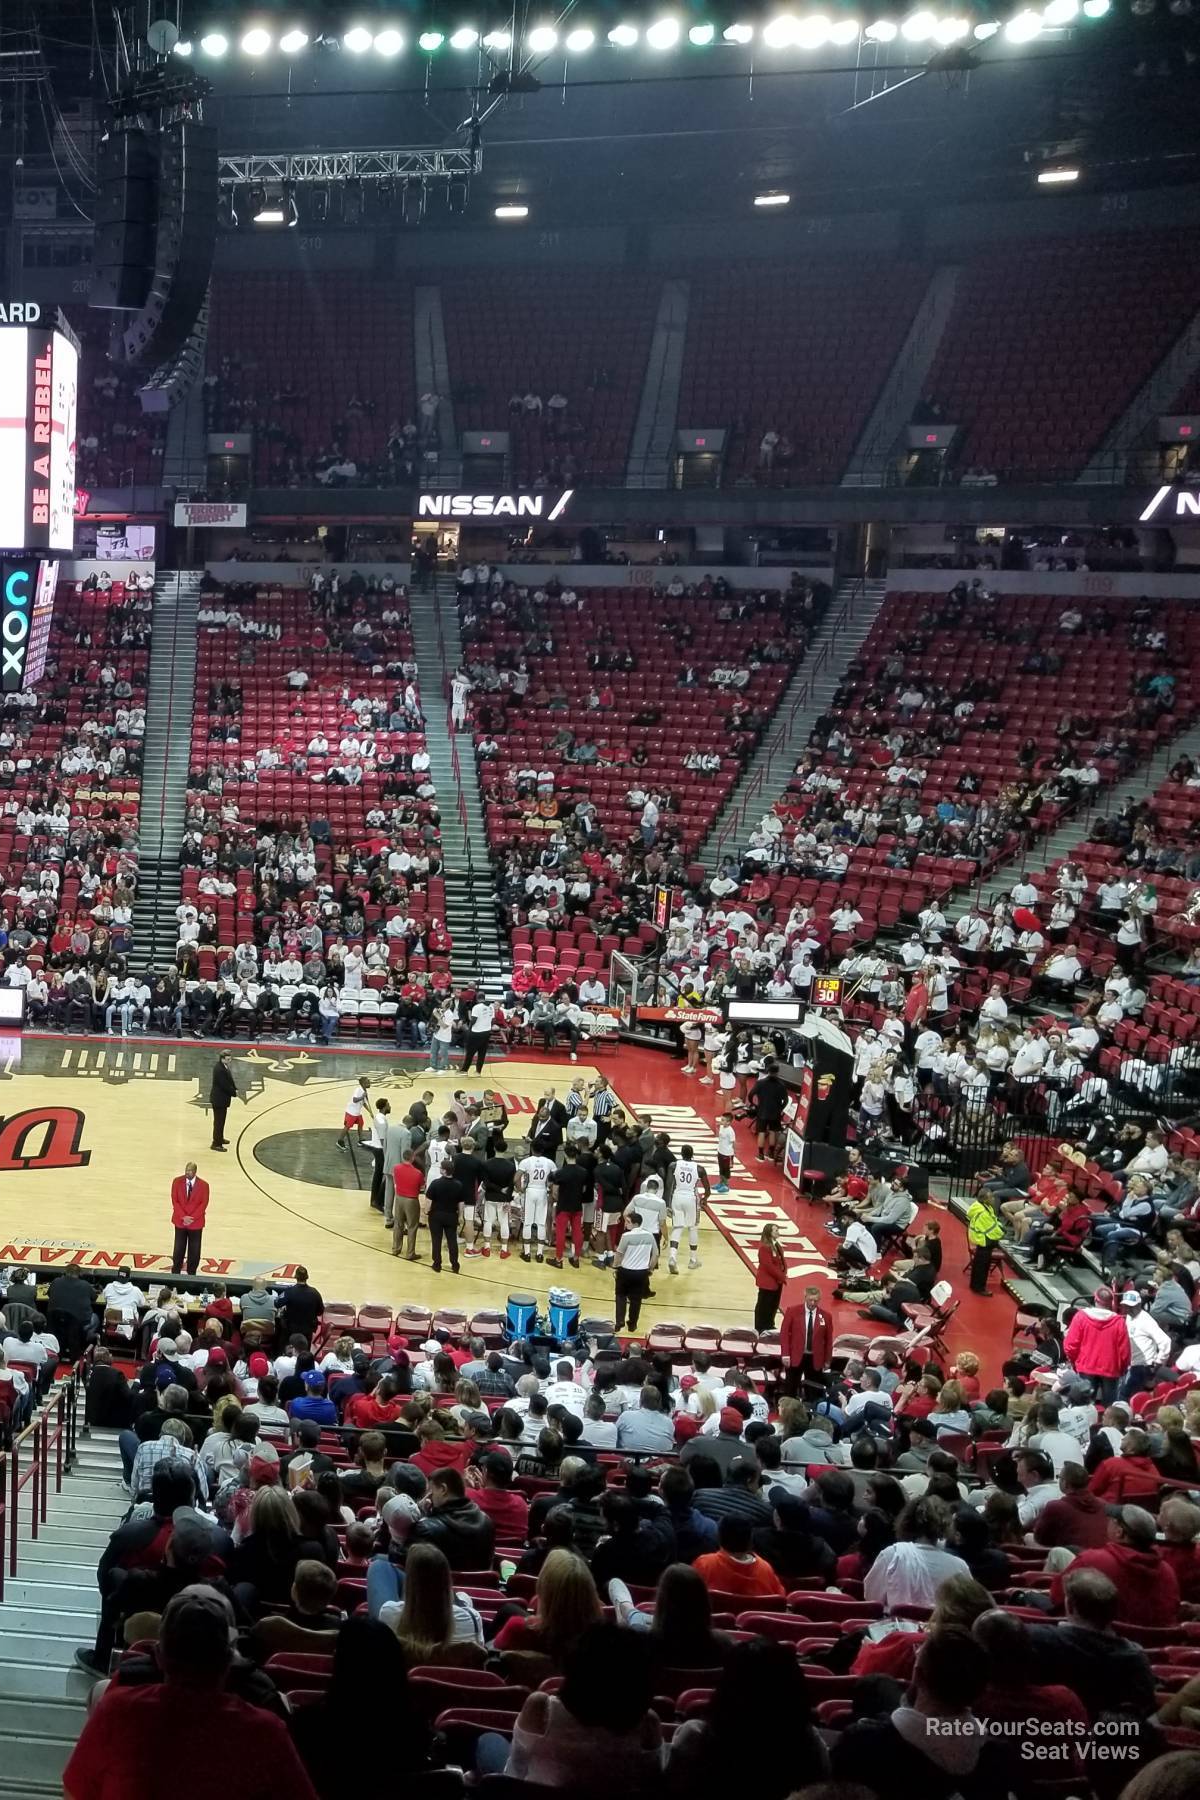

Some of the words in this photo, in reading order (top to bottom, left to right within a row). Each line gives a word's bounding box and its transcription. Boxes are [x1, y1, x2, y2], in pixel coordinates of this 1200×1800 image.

[33, 454, 49, 478] A
[32, 488, 49, 524] BE
[419, 495, 542, 516] NISSAN
[2, 571, 29, 675] COX
[817, 980, 839, 990] 11:30
[818, 990, 835, 1002] 30
[533, 1168, 545, 1181] 20
[679, 1172, 692, 1184] 30
